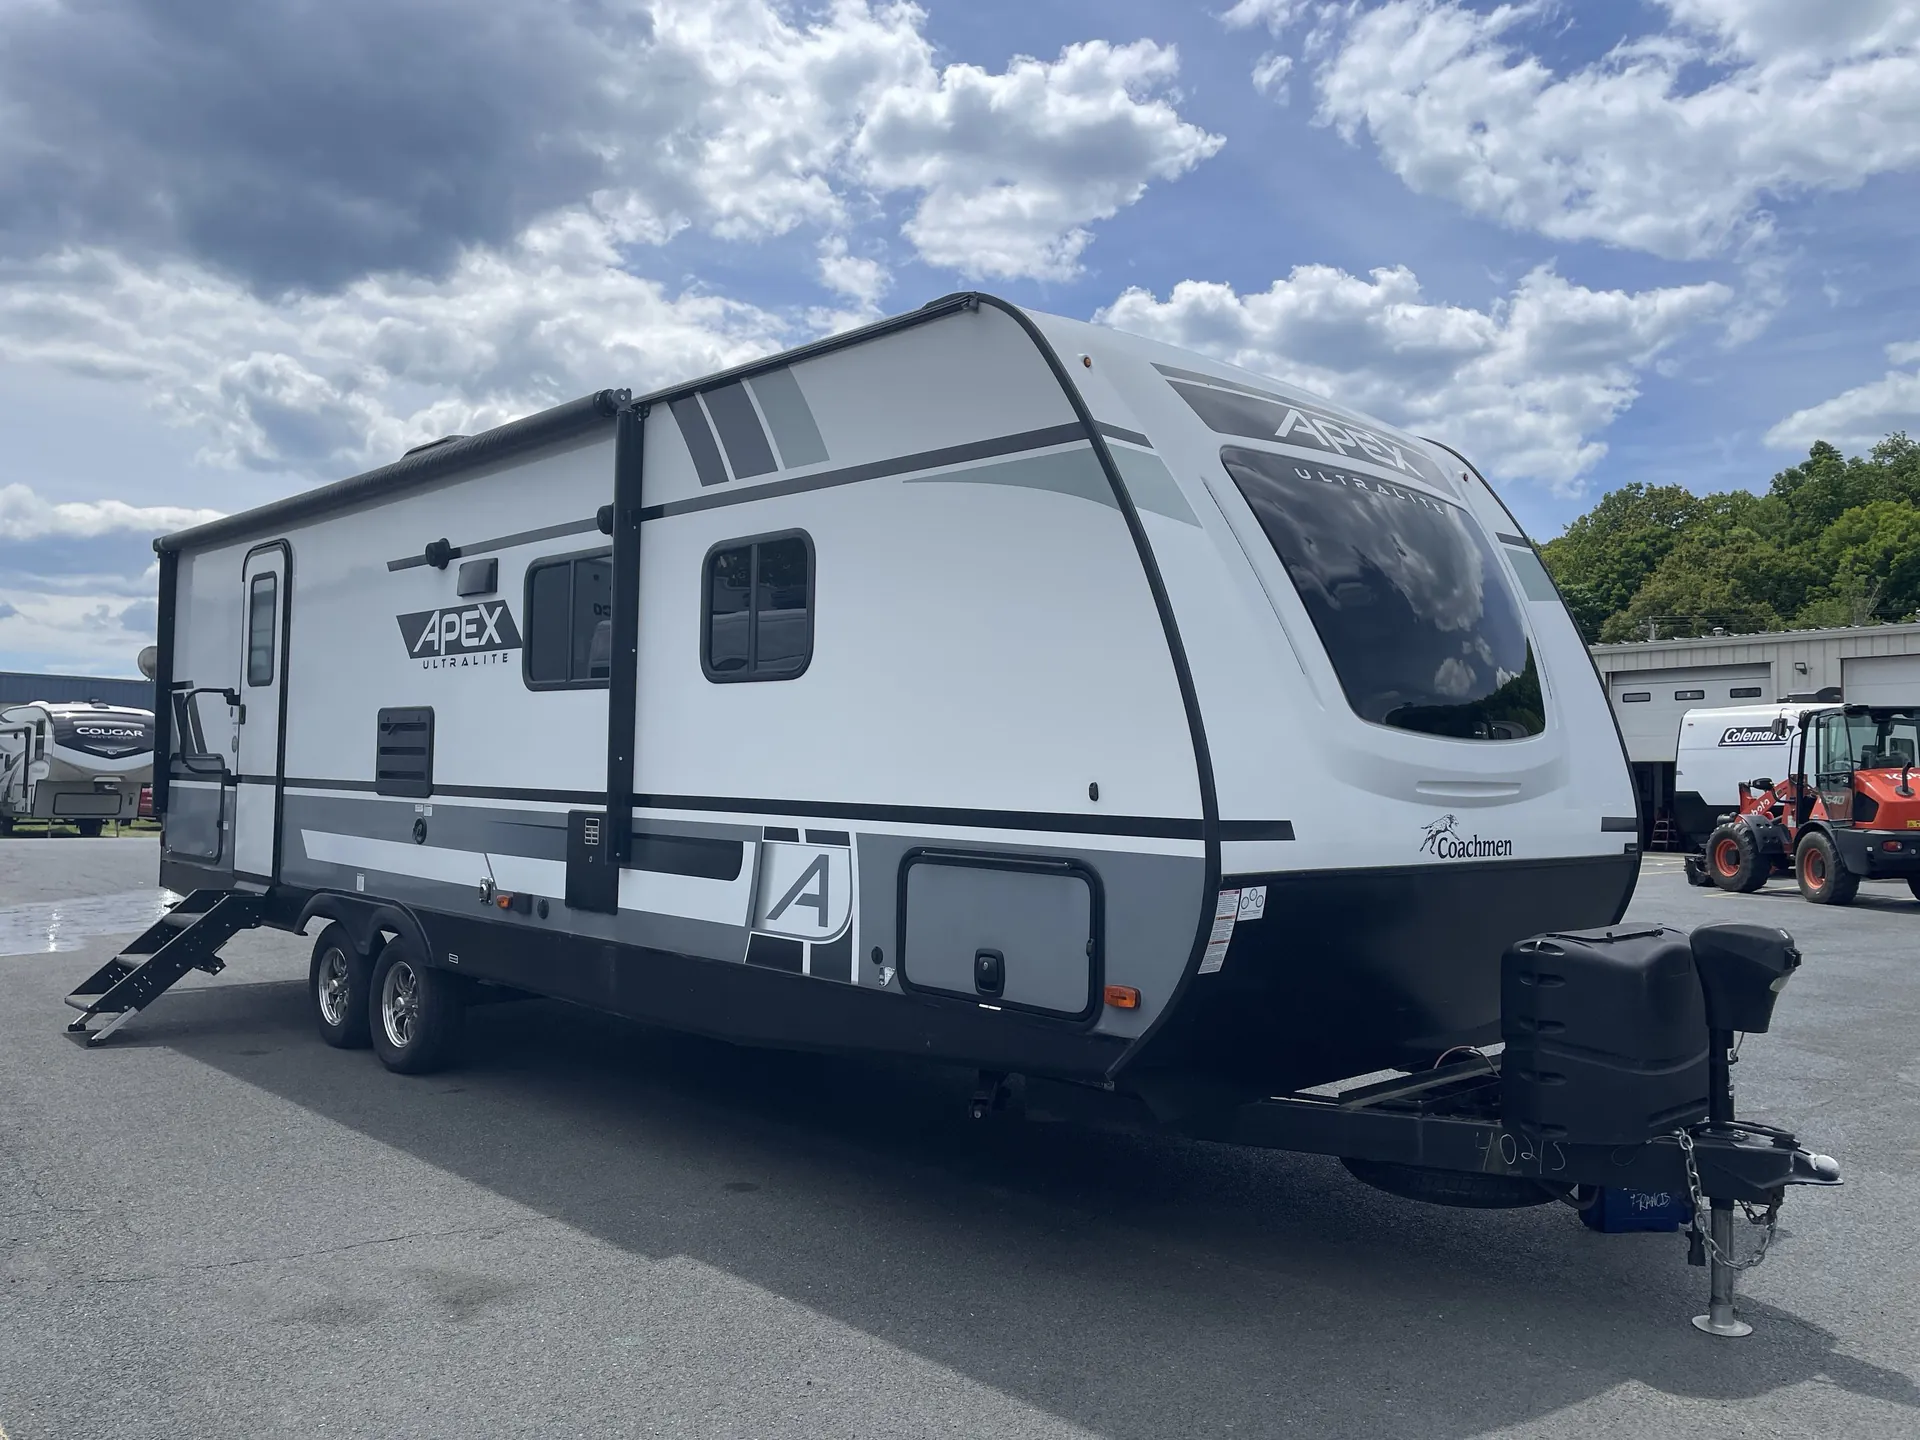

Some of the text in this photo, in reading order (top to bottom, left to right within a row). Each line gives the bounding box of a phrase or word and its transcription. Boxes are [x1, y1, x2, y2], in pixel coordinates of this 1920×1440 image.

[1275, 408, 1425, 479] APEX
[1294, 467, 1445, 515] ULTRALITE
[412, 603, 504, 656] APEX
[422, 652, 509, 670] ULTRALITE
[76, 726, 144, 737] COUGAR
[1437, 834, 1513, 859] Coachmen
[765, 853, 830, 928] A
